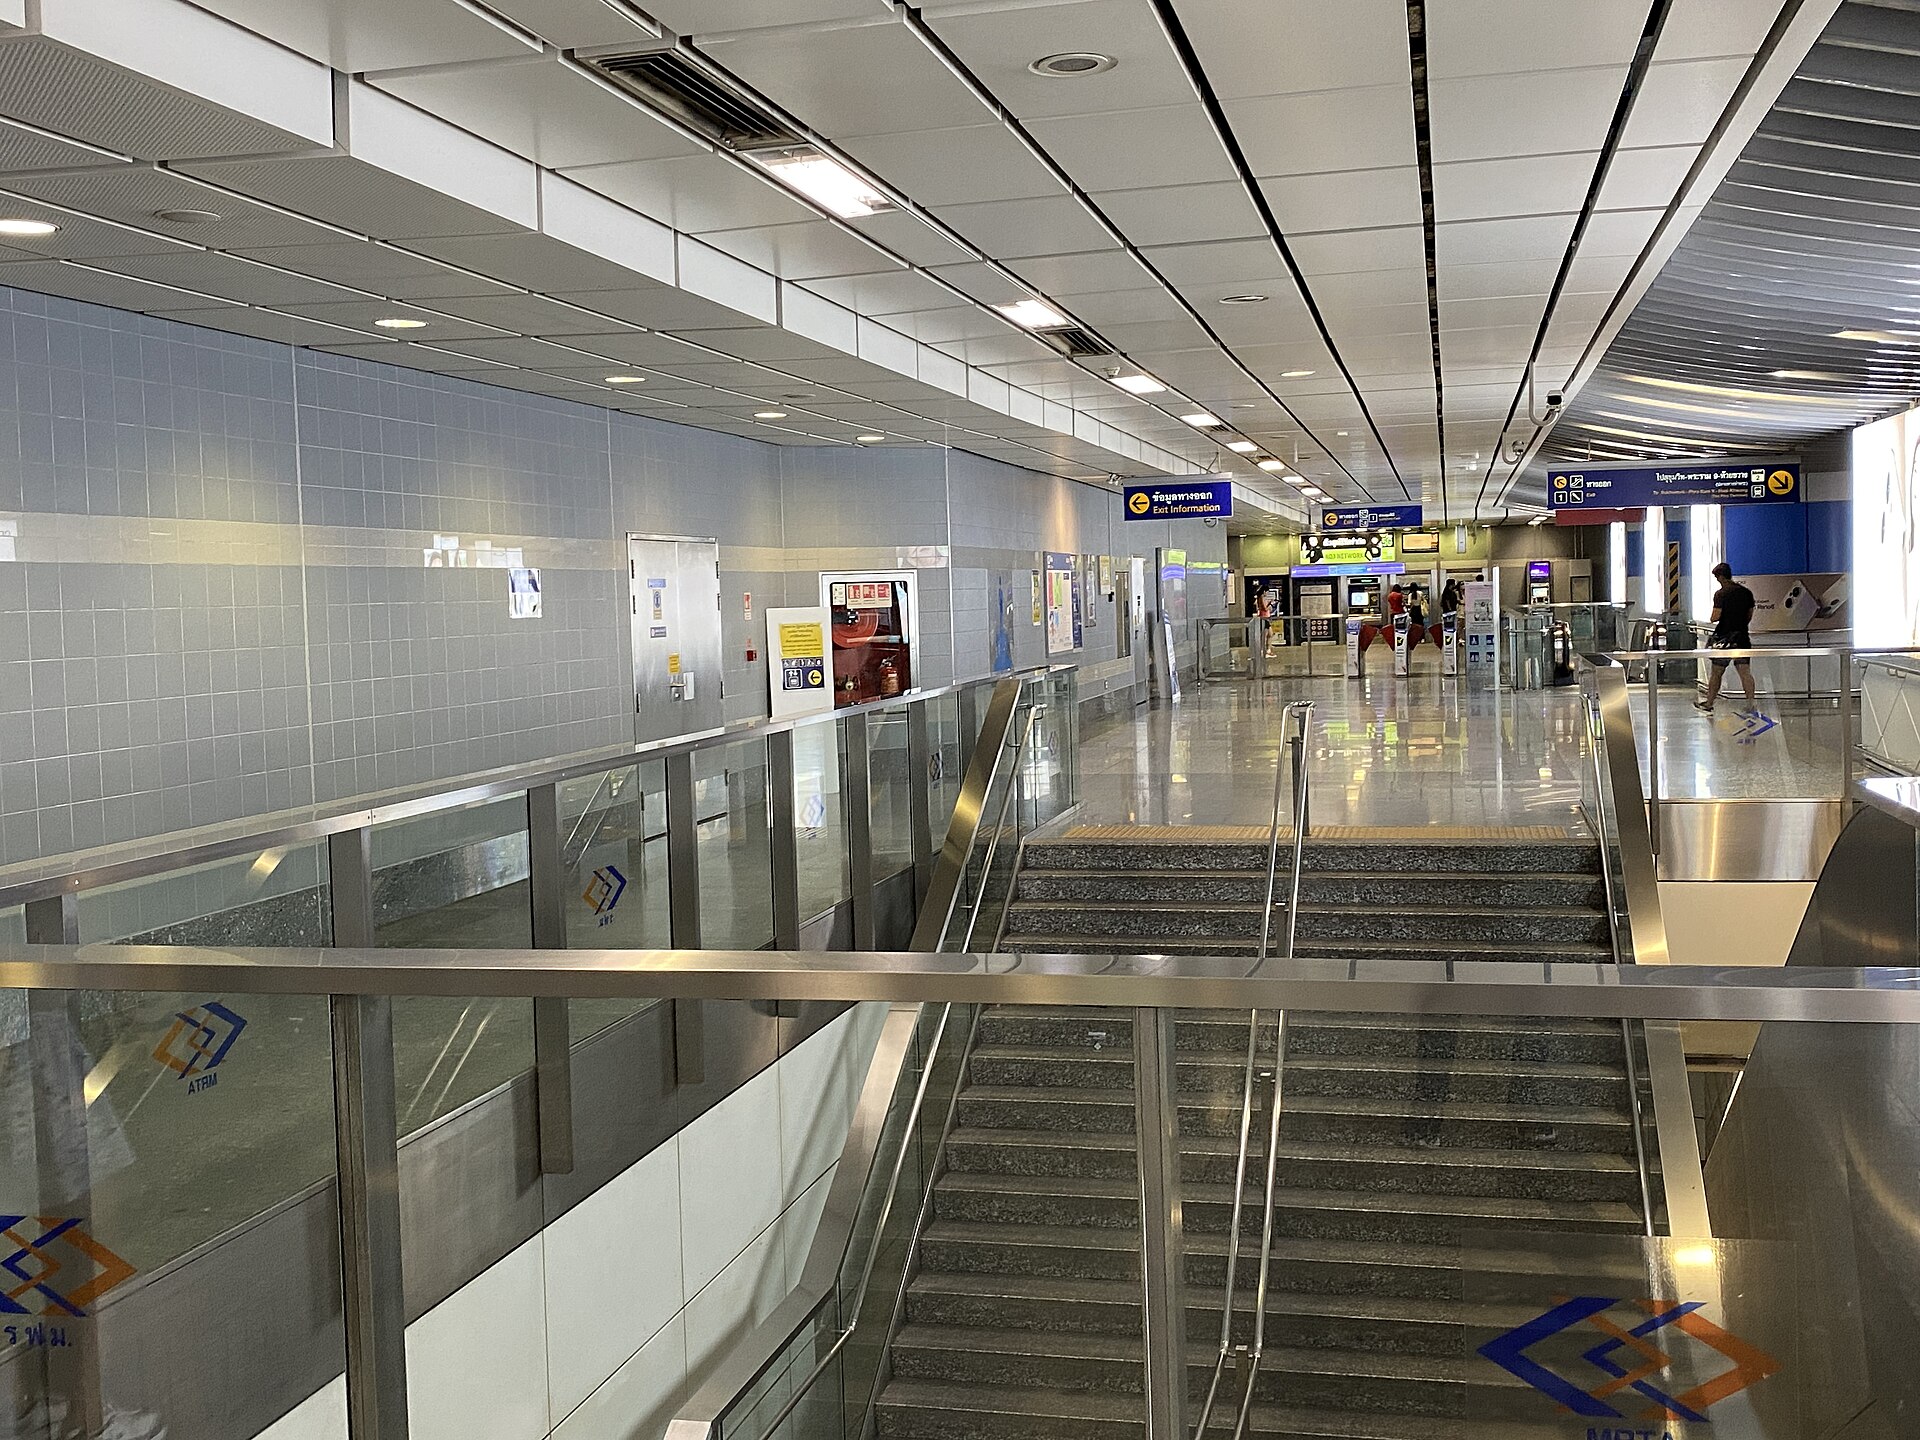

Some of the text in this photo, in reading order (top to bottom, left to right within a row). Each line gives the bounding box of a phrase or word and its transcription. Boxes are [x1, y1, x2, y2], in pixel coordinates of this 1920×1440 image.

[1152, 491, 1213, 504] ข้อมูลทางออก
[1153, 504, 1220, 514] Exit Information
